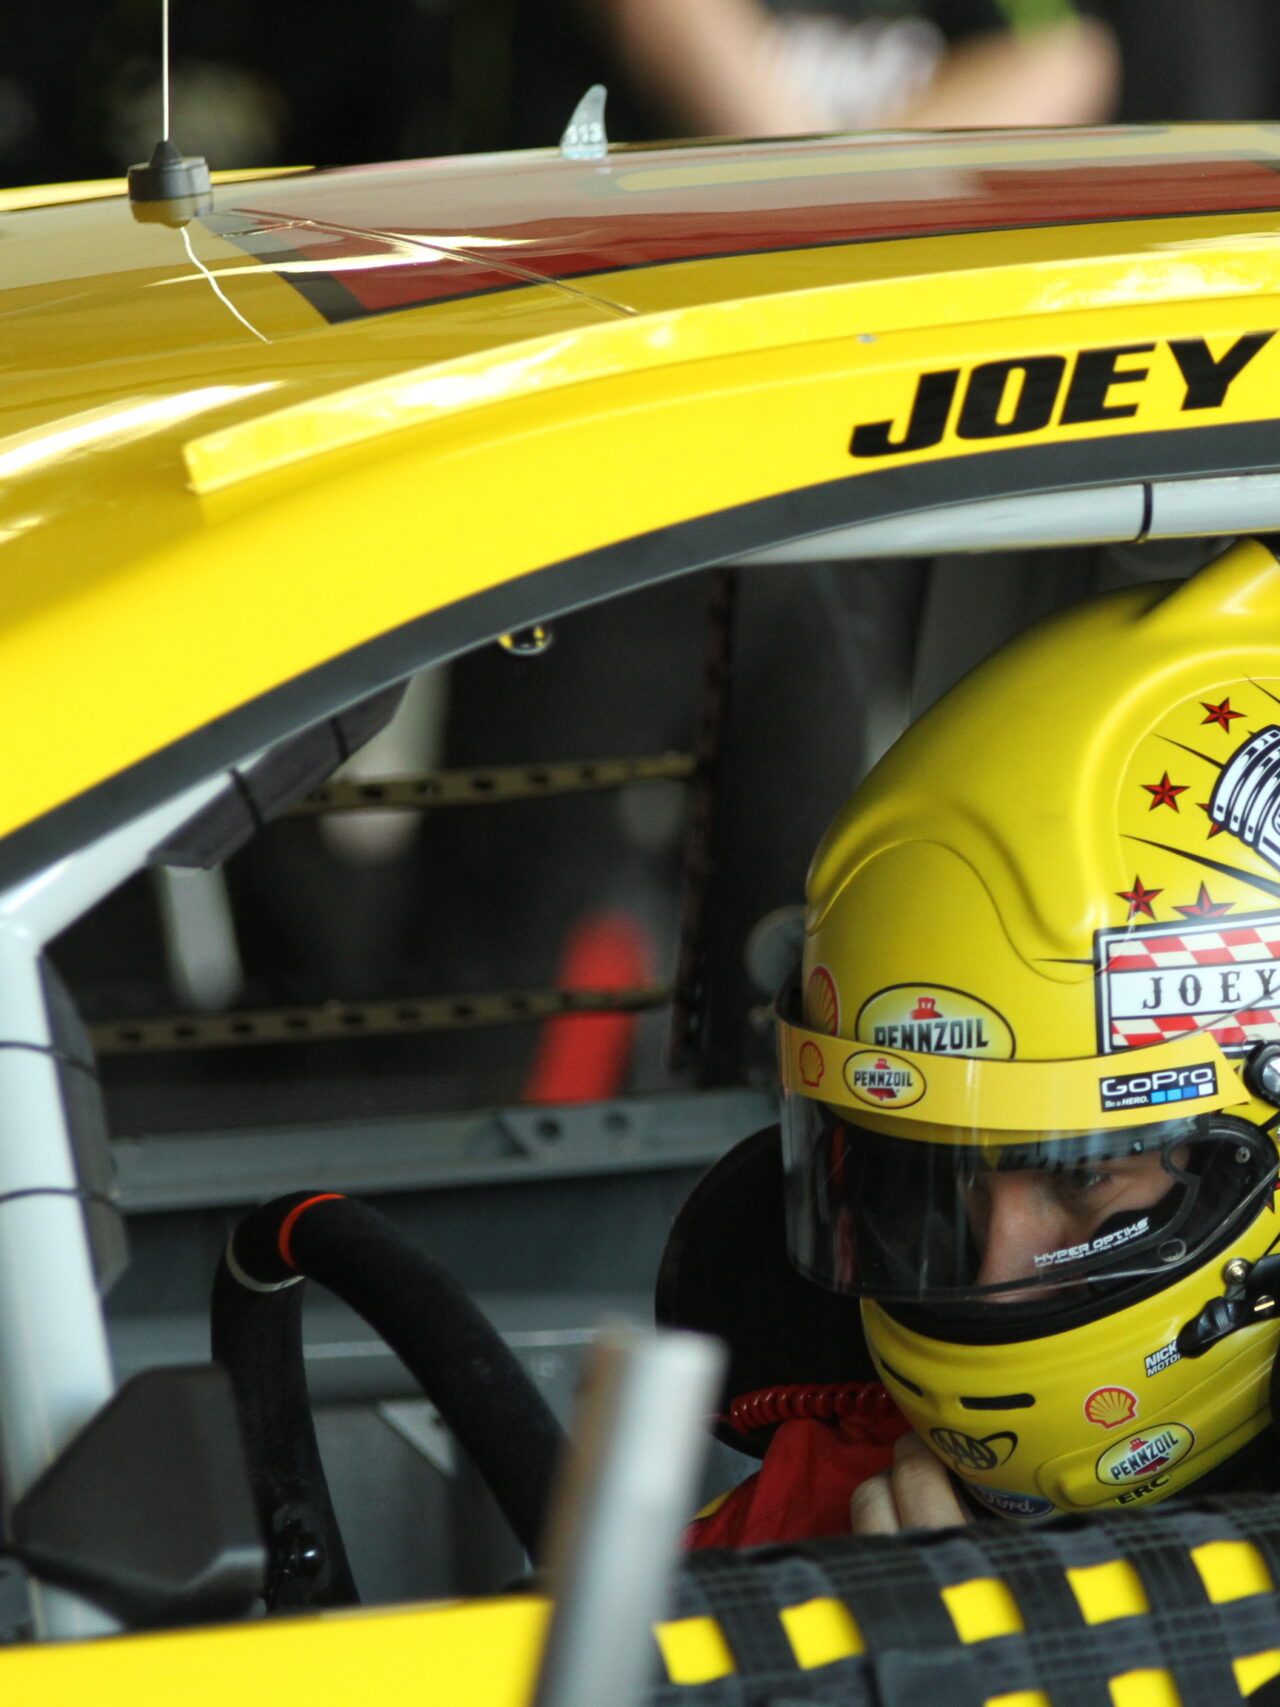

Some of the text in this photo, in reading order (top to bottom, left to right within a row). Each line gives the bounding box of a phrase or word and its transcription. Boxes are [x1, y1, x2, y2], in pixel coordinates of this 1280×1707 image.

[850, 332, 1277, 456] JOEY
[1142, 968, 1277, 1009] JOEY
[874, 1017, 990, 1052] PENNZOIL
[853, 1070, 914, 1088] PENNZOIL
[1101, 1068, 1213, 1096] GoPro
[1034, 1242, 1090, 1264] HYPER
[1110, 1430, 1180, 1481] PENNZOIL
